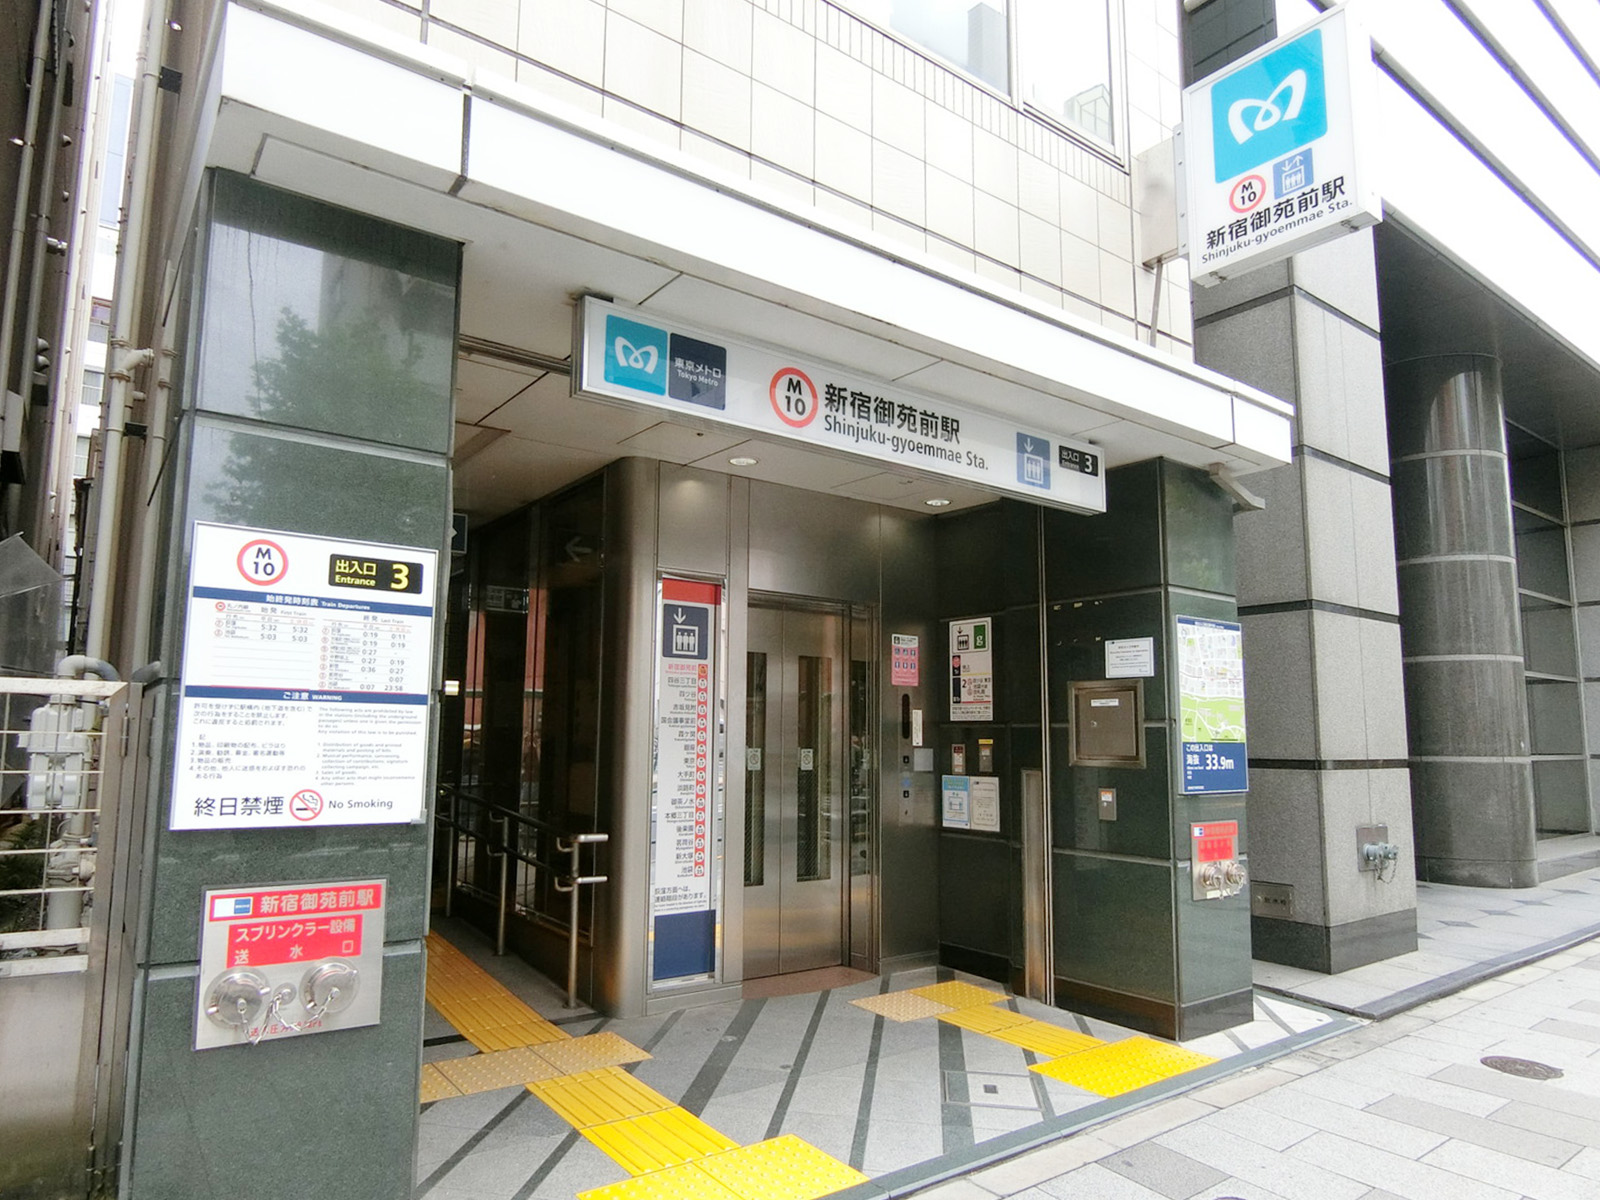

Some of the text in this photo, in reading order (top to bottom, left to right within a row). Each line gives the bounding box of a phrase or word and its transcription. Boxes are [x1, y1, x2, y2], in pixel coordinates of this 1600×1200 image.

[1242, 182, 1253, 194] M
[1241, 192, 1256, 206] 10
[1206, 176, 1345, 250] 新宿御苑前駅
[1202, 200, 1352, 264] Shinjuku-gyoemmae Sta.
[674, 356, 722, 379] 東京メトロ
[678, 370, 718, 387] Tokyo Metro
[787, 378, 802, 396] M
[784, 395, 806, 416] 10
[824, 383, 960, 445] 新宿御苑前駅
[824, 415, 988, 470] Shinjuku-gyoemmae Sta.
[1084, 455, 1092, 473] 3
[256, 546, 272, 560] M
[254, 562, 275, 576] 10
[335, 560, 410, 590] 出入口 3
[335, 575, 376, 586] Entrance
[266, 594, 319, 606] 始終発時刻表
[962, 680, 967, 688] 2
[283, 692, 309, 700] ご注意
[1205, 754, 1234, 770] 33.9m
[194, 796, 393, 818] 終日禁煙 No Smoking
[260, 888, 374, 914] 新宿御苑前駅
[235, 918, 356, 943] スプリンクラー設備
